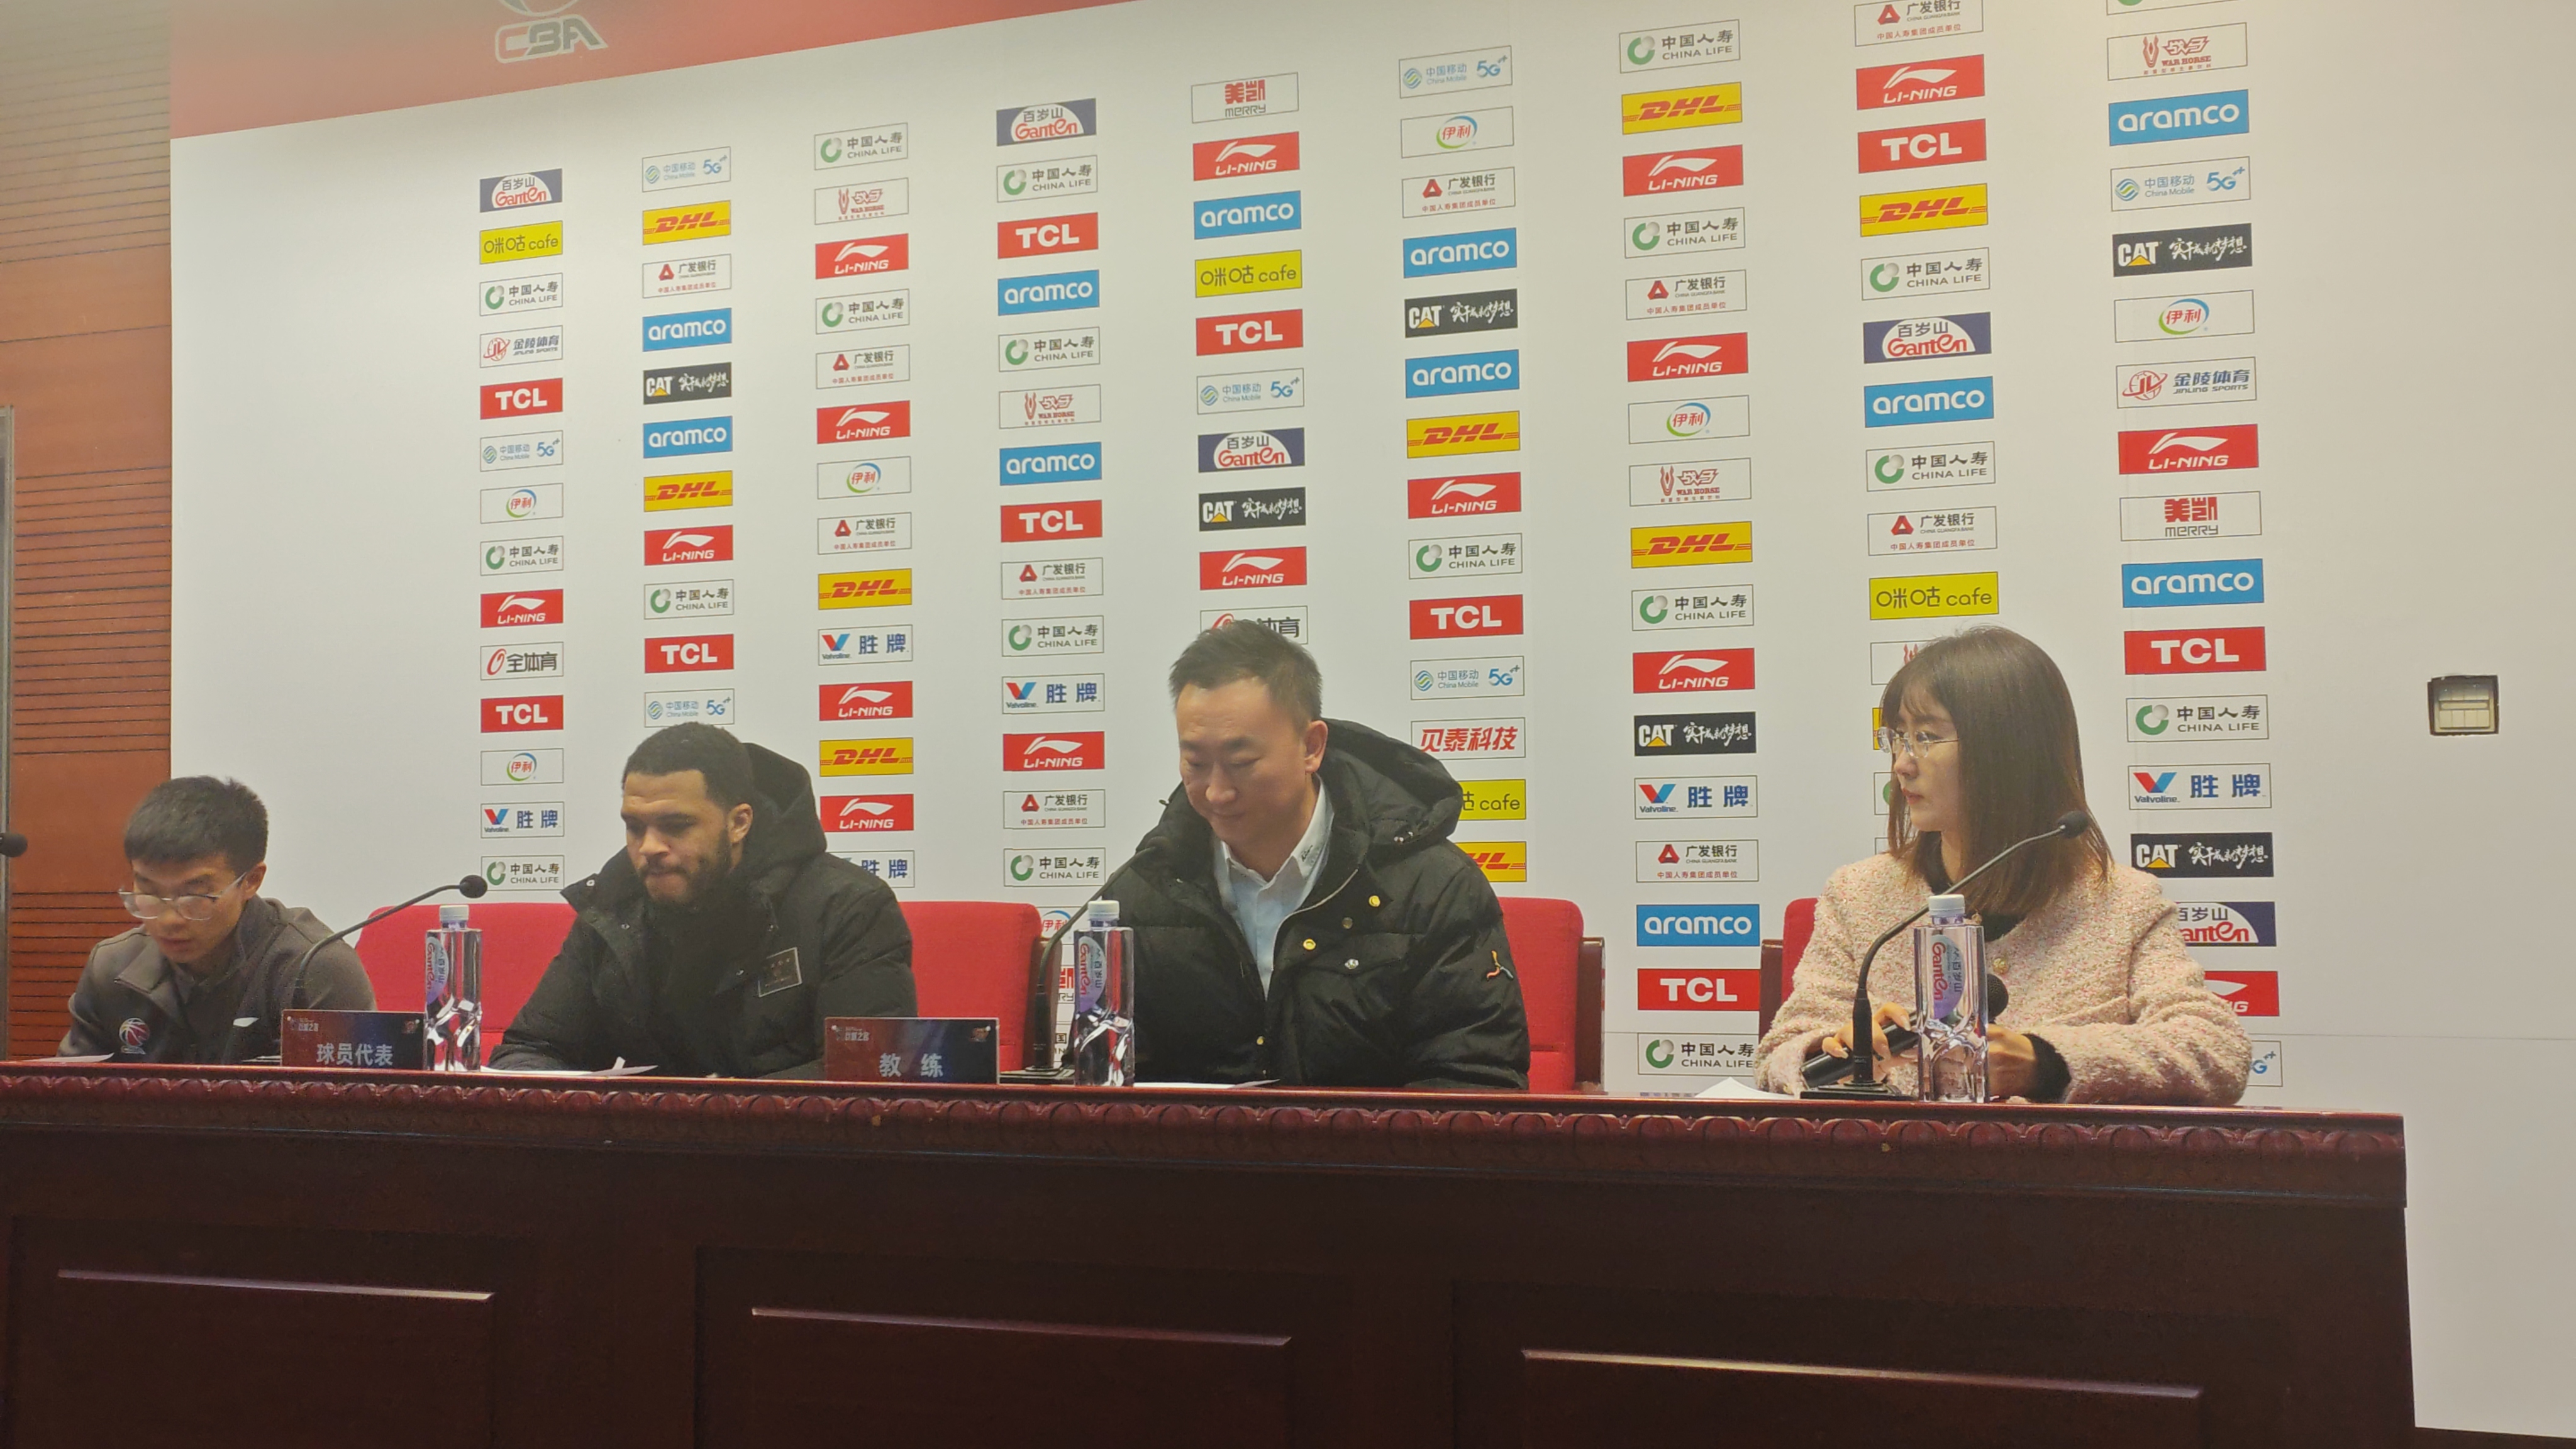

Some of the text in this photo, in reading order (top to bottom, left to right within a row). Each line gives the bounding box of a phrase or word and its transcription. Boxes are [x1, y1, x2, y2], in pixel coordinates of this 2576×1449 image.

[496, 14, 608, 64] CBA
[1662, 30, 1733, 50] 中国人寿
[1662, 45, 1732, 60] CHINA LIFE
[1426, 63, 1467, 77] 中国移动
[1224, 79, 1265, 104] 美凯
[1884, 86, 1957, 103] LI-NING
[1023, 106, 1063, 124] 百岁山
[1638, 95, 1723, 120] DHL
[2118, 104, 2239, 131] aramco
[1014, 118, 1078, 142] Ganten
[1441, 123, 1471, 142] 伊利
[847, 132, 902, 149] 中国人寿
[1881, 132, 1962, 160] TCL
[1032, 164, 1091, 182] 中国人寿
[1215, 159, 1277, 175] LI-NING
[501, 175, 535, 192] 百岁山
[1448, 174, 1495, 190] 广发银行
[1648, 174, 1718, 191] LI-NING
[2145, 174, 2194, 191] 中国移动
[494, 187, 547, 208] Ganten
[2167, 187, 2195, 196] Mobile
[1201, 203, 1294, 227] aramco
[1877, 197, 1967, 222] DHL
[654, 211, 717, 233] DHL
[1667, 217, 1738, 236] 中国人寿
[484, 233, 558, 254] 咪咕 cafe
[1016, 223, 1079, 248] TCL
[1667, 233, 1737, 246] CHINA LIFE
[1411, 240, 1509, 265] aramco
[2118, 242, 2159, 266] CAT
[834, 259, 889, 274] LI-NING
[1201, 264, 1296, 286] 咪咕 cafe
[1906, 258, 1982, 277] 中国人寿
[509, 281, 558, 297] 中国人寿
[1675, 276, 1725, 292] 广发银行
[1907, 274, 1981, 287] CHINA LIFE
[1004, 282, 1092, 304] aramco
[848, 297, 904, 314] 中国人寿
[1409, 305, 1442, 328] CAT
[2164, 306, 2202, 326] 伊利
[648, 319, 726, 340] aramco
[1215, 320, 1283, 345] TCL
[1897, 320, 1949, 339] 百岁山
[513, 335, 559, 352] 金陵体育
[1034, 336, 1094, 352] 中国人寿
[1887, 334, 1968, 359] Ganten
[1413, 362, 1511, 386] aramco
[1653, 362, 1722, 376] LI-NING
[647, 376, 672, 396] CAT
[2174, 369, 2250, 389] 金陵体育
[1222, 383, 1261, 396] 中国移动
[495, 388, 547, 410] TCL
[1873, 390, 1984, 414] aramco
[1671, 410, 1704, 428] 伊利
[648, 427, 726, 447] aramco
[836, 426, 891, 440] LI-NING
[1226, 434, 1270, 450] 百岁山
[1421, 423, 1502, 445] DHL
[1006, 453, 1095, 474] aramco
[1217, 448, 1285, 469] Ganten
[1911, 451, 1987, 469] 中国人寿
[2148, 455, 2228, 469] LI-NING
[850, 470, 875, 486] 伊利
[1912, 468, 1987, 480] CHINA LIFE
[655, 481, 719, 500] DHL
[509, 496, 532, 511] 伊利
[1202, 501, 1234, 523] CAT
[1431, 500, 1497, 514] LI-NING
[2165, 496, 2217, 523] 美凯
[855, 518, 895, 530] 广发银行
[1019, 510, 1083, 533] TCL
[1920, 513, 1974, 528] 广发银行
[509, 544, 558, 558] 中国人寿
[1448, 542, 1516, 558] 中国人寿
[1647, 533, 1733, 555] DHL
[662, 550, 714, 562] LI-NING
[1449, 558, 1514, 569] CHINA LIFE
[1042, 563, 1085, 575] 广发银行
[830, 579, 897, 597] DHL
[1222, 573, 1284, 586] LI-NING
[2131, 572, 2253, 594] aramco
[675, 587, 728, 601] 中国人寿
[1675, 594, 1746, 610] 中国人寿
[1876, 586, 1992, 608] 咪咕 cafe
[497, 613, 545, 624] LI-NING
[1430, 605, 1501, 629] TCL
[1675, 610, 1746, 620] CHINA LIFE
[1038, 624, 1098, 638] 中国人寿
[858, 633, 906, 654] 胜牌
[2151, 638, 2239, 664] TCL
[660, 643, 717, 664] TCL
[1438, 669, 1479, 680] 中国移动
[1658, 676, 1729, 689] LI-NING
[1046, 682, 1097, 703] 胜牌
[496, 704, 548, 724] TCL
[838, 706, 892, 717] LI-NING
[2177, 705, 2263, 721] 中国人寿
[1639, 724, 1675, 747] CAT
[2177, 723, 2259, 732] CHINA LIFE
[1419, 726, 1518, 753] 贝泰科技
[832, 748, 899, 765] DHL
[1024, 757, 1083, 768] LI-NING
[509, 760, 532, 774] 伊利
[2190, 774, 2260, 798] 胜牌
[1044, 794, 1087, 806] 广发银行
[1480, 793, 1520, 811] cafe
[1687, 785, 1748, 808] 胜牌
[516, 809, 557, 828] 胜牌
[839, 819, 894, 829] LI-NING
[1686, 845, 1736, 857] 广发银行
[2136, 844, 2178, 868] CAT
[510, 863, 559, 875] 中国人寿
[1039, 857, 1099, 870] 中国人寿
[1645, 916, 1752, 934] aramco
[2180, 921, 2249, 942] anten
[1660, 977, 1737, 1002] TCL
[316, 1043, 393, 1066] 球员代表
[1681, 1042, 1754, 1057] 中国人寿
[879, 1053, 943, 1078] 教练
[1726, 1060, 1753, 1068] LIFE
